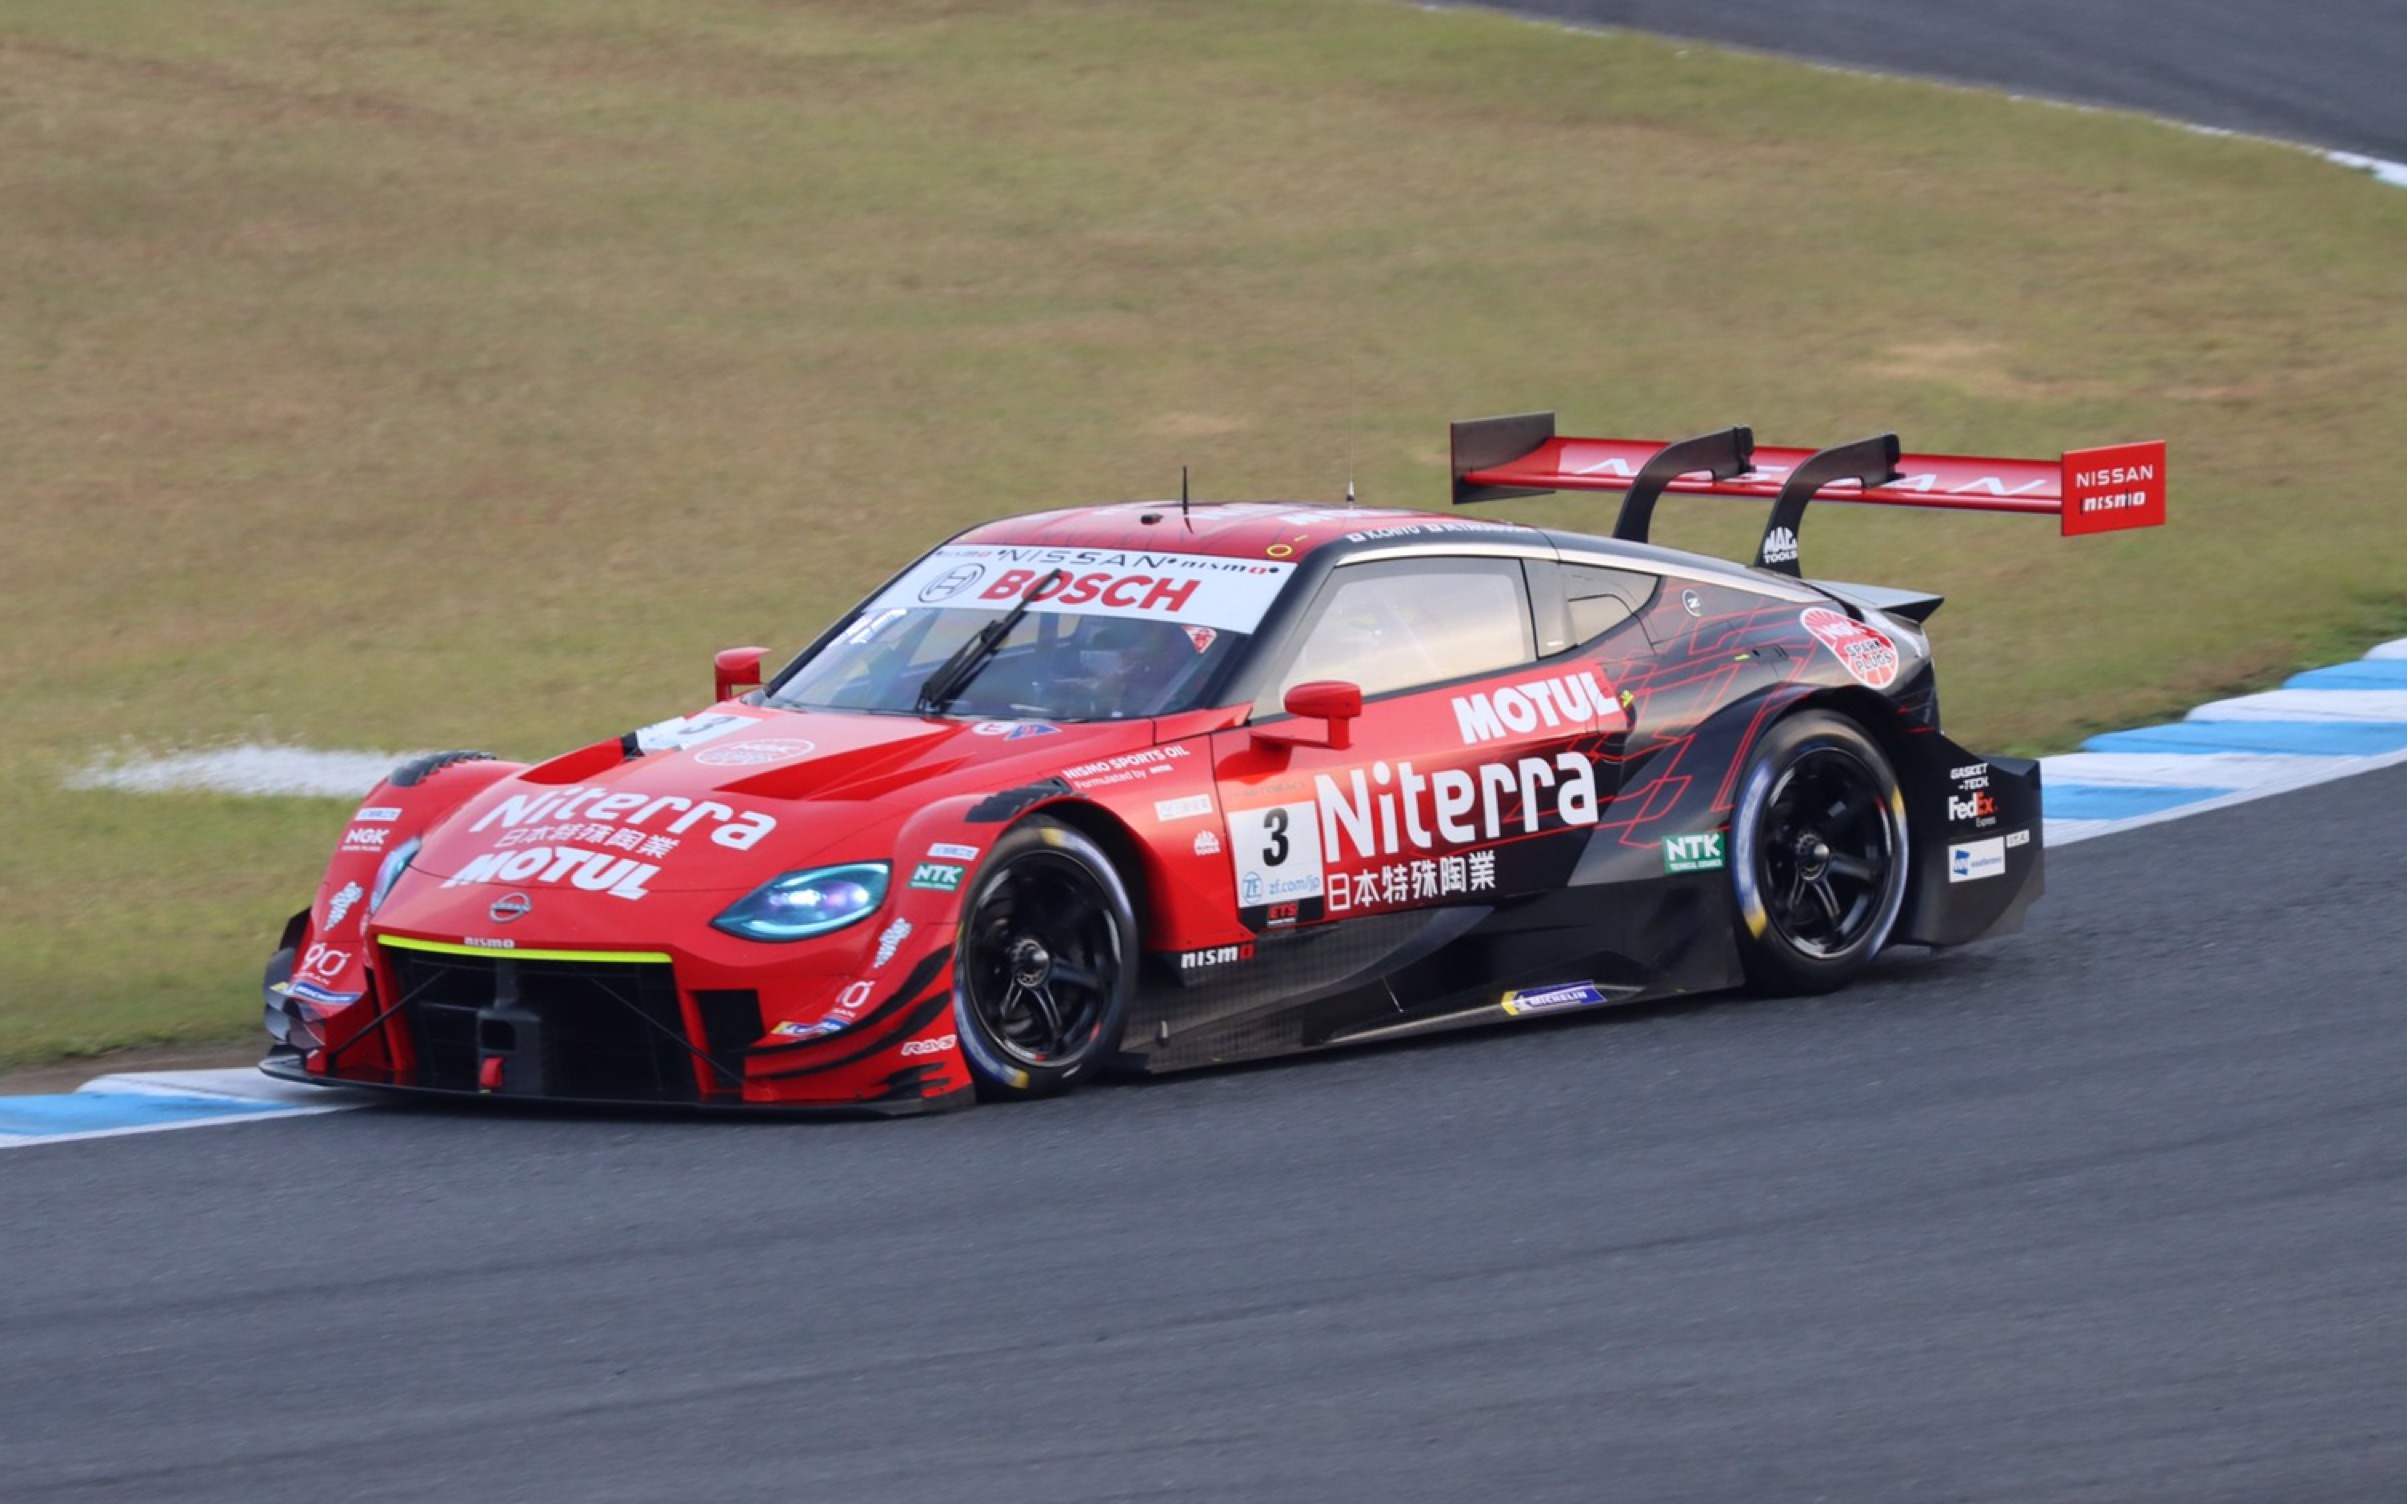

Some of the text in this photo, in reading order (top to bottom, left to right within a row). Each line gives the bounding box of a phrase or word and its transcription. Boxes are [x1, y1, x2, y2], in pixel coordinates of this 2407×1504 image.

[2076, 463, 2154, 488] NISSAN
[2081, 489, 2146, 513] nismo
[1764, 526, 1797, 554] MAC
[1000, 548, 1168, 570] NISSAN
[1180, 560, 1268, 575] nismo
[1765, 552, 1797, 564] TOOLS
[978, 568, 1202, 613] BOSCH
[1855, 651, 1892, 672] PLUGS
[1451, 671, 1621, 745] MOTUL
[1062, 761, 1111, 779] NISMO
[1109, 749, 1166, 769] SPORTS
[1164, 745, 1190, 758] OIL
[469, 786, 777, 850] Niterra
[1314, 750, 1599, 864] Niterra
[1948, 791, 1995, 821] FedEx
[345, 828, 390, 844] NGK
[493, 822, 681, 860] 日本特殊陶業
[1262, 807, 1290, 867] 3
[1666, 833, 1721, 862] NTK
[440, 846, 662, 901] MOTUL
[914, 864, 963, 884] NTK
[1328, 850, 1496, 912] 日本特殊陶業
[1181, 944, 1255, 969] nismo
